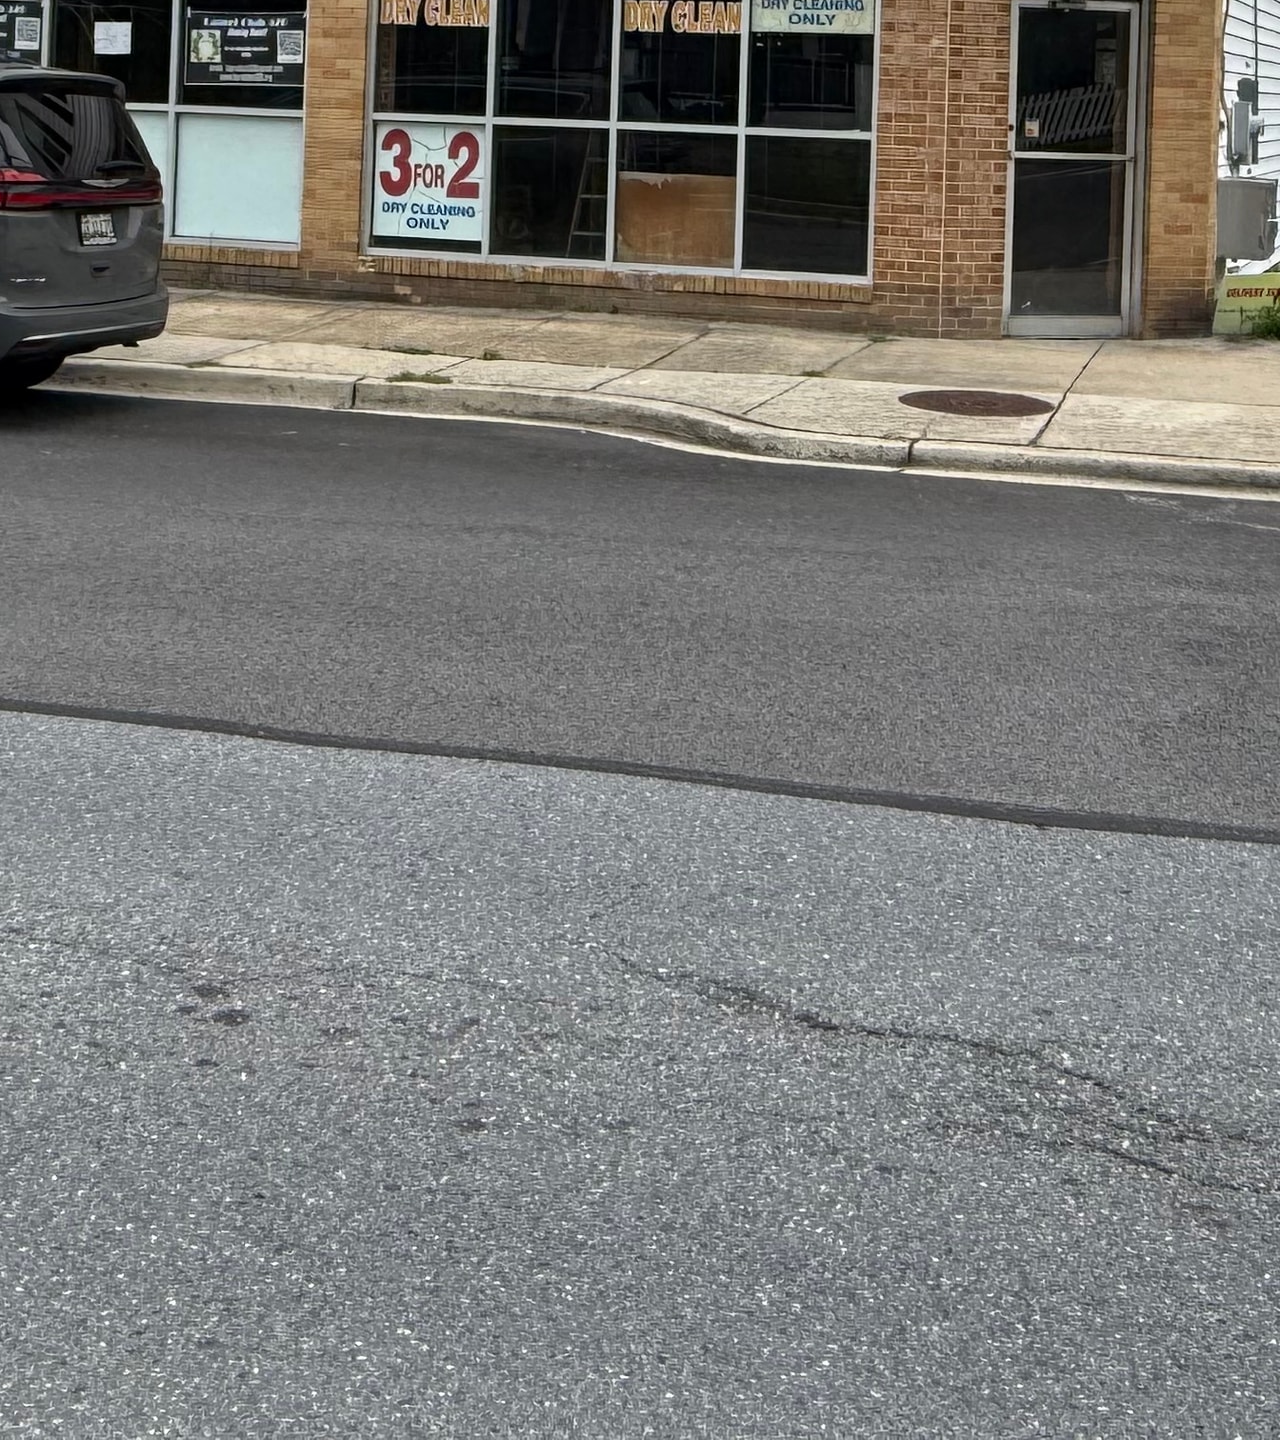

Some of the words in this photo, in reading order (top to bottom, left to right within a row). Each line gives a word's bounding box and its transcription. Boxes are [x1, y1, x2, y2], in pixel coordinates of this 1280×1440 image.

[623, 0, 669, 32] DRY
[671, 1, 742, 34] CLEAN
[788, 13, 837, 26] ONLY
[380, 128, 413, 197] 3
[414, 163, 445, 189] FOR
[446, 131, 480, 199] 2
[382, 201, 408, 214] DRY
[410, 203, 477, 218] CLEANING
[406, 217, 450, 230] ONLY
